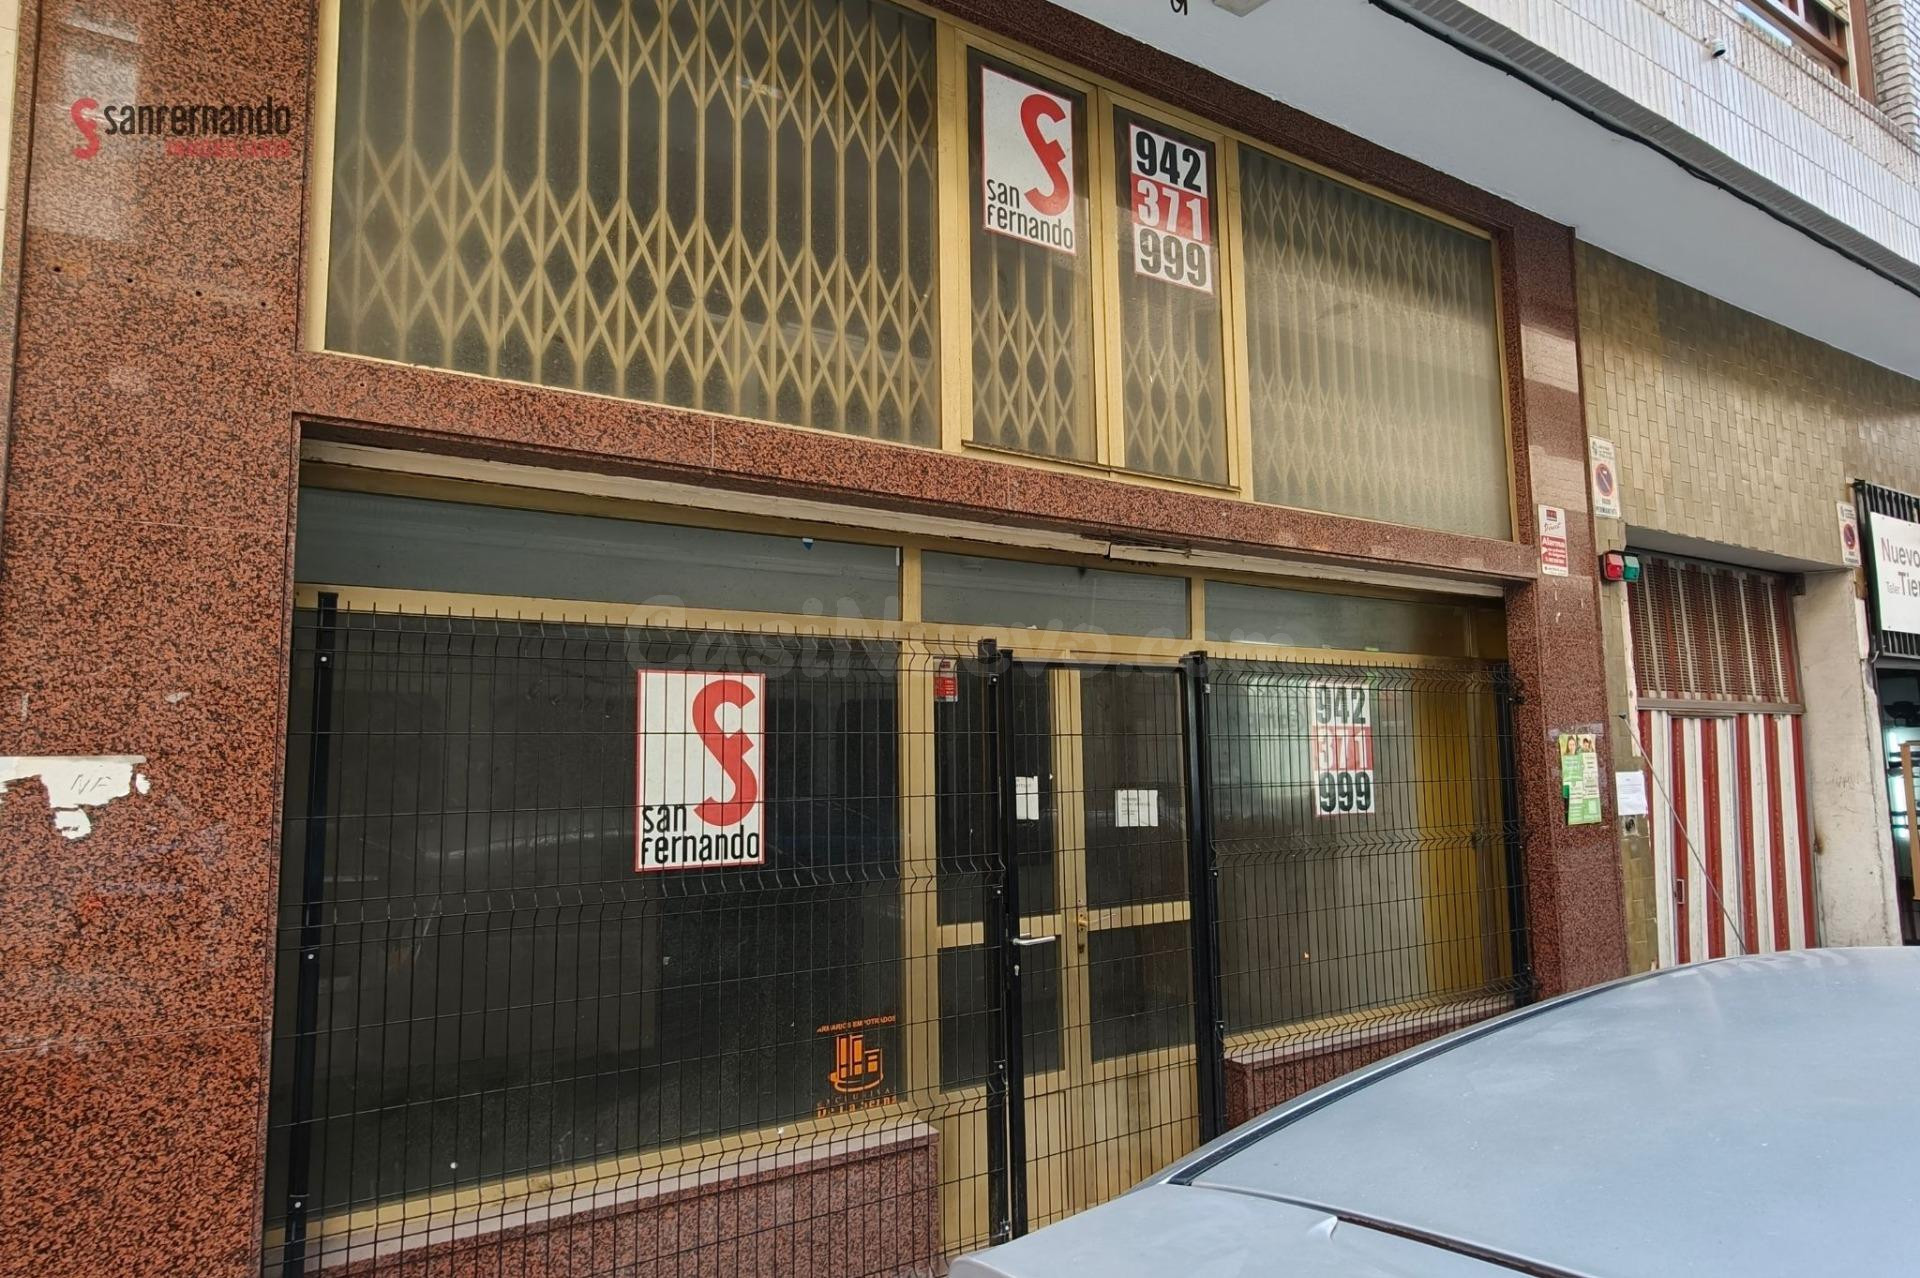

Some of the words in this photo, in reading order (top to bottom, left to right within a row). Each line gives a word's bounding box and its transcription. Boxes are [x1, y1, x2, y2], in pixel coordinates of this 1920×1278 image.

[1135, 131, 1201, 192] 942
[986, 178, 1020, 208] san
[1137, 180, 1203, 240] 371
[987, 204, 1073, 249] fernando
[1139, 228, 1206, 288] 999
[1898, 571, 1920, 597] Tie
[1315, 685, 1366, 724] 942
[1318, 729, 1368, 769] 371
[1319, 771, 1371, 812] 999
[642, 804, 687, 833] san
[641, 825, 760, 865] fernando
